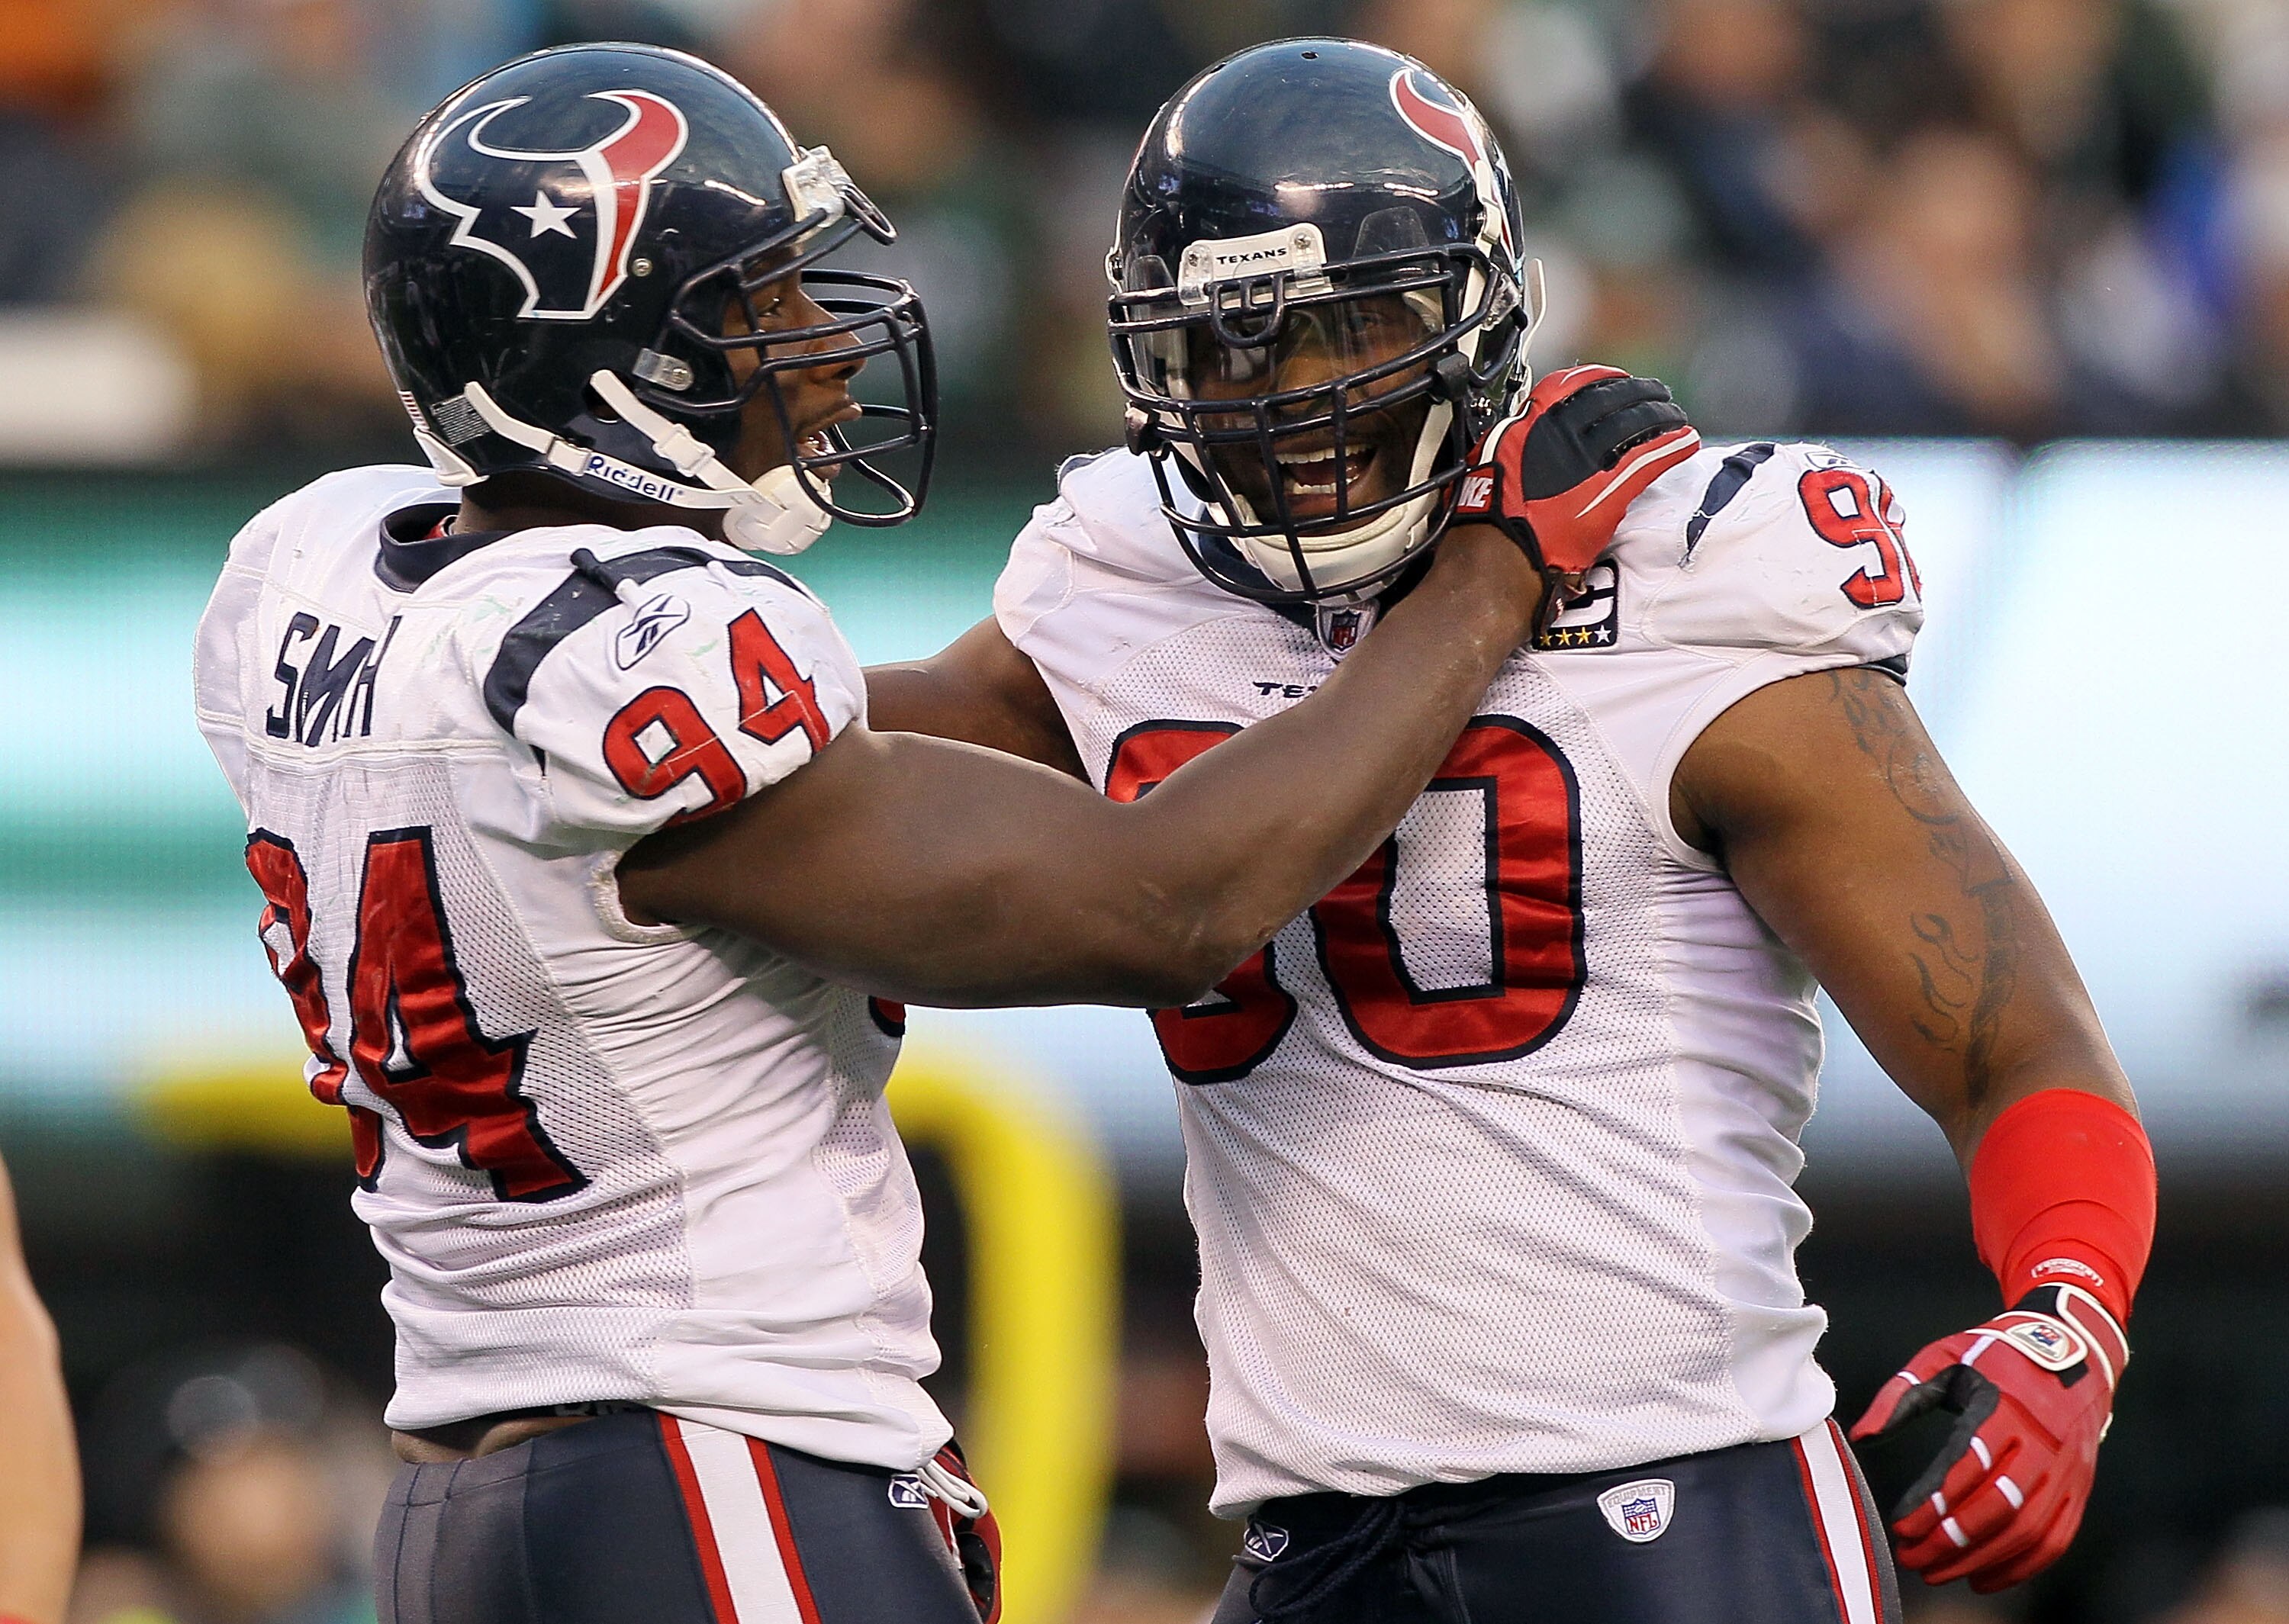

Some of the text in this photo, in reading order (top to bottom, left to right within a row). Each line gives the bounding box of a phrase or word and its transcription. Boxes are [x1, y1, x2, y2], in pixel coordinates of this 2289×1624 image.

[1216, 247, 1287, 265] TEXANS
[266, 611, 403, 747] SMH
[603, 607, 830, 828] 94
[1627, 1513, 1658, 1533] NFL
